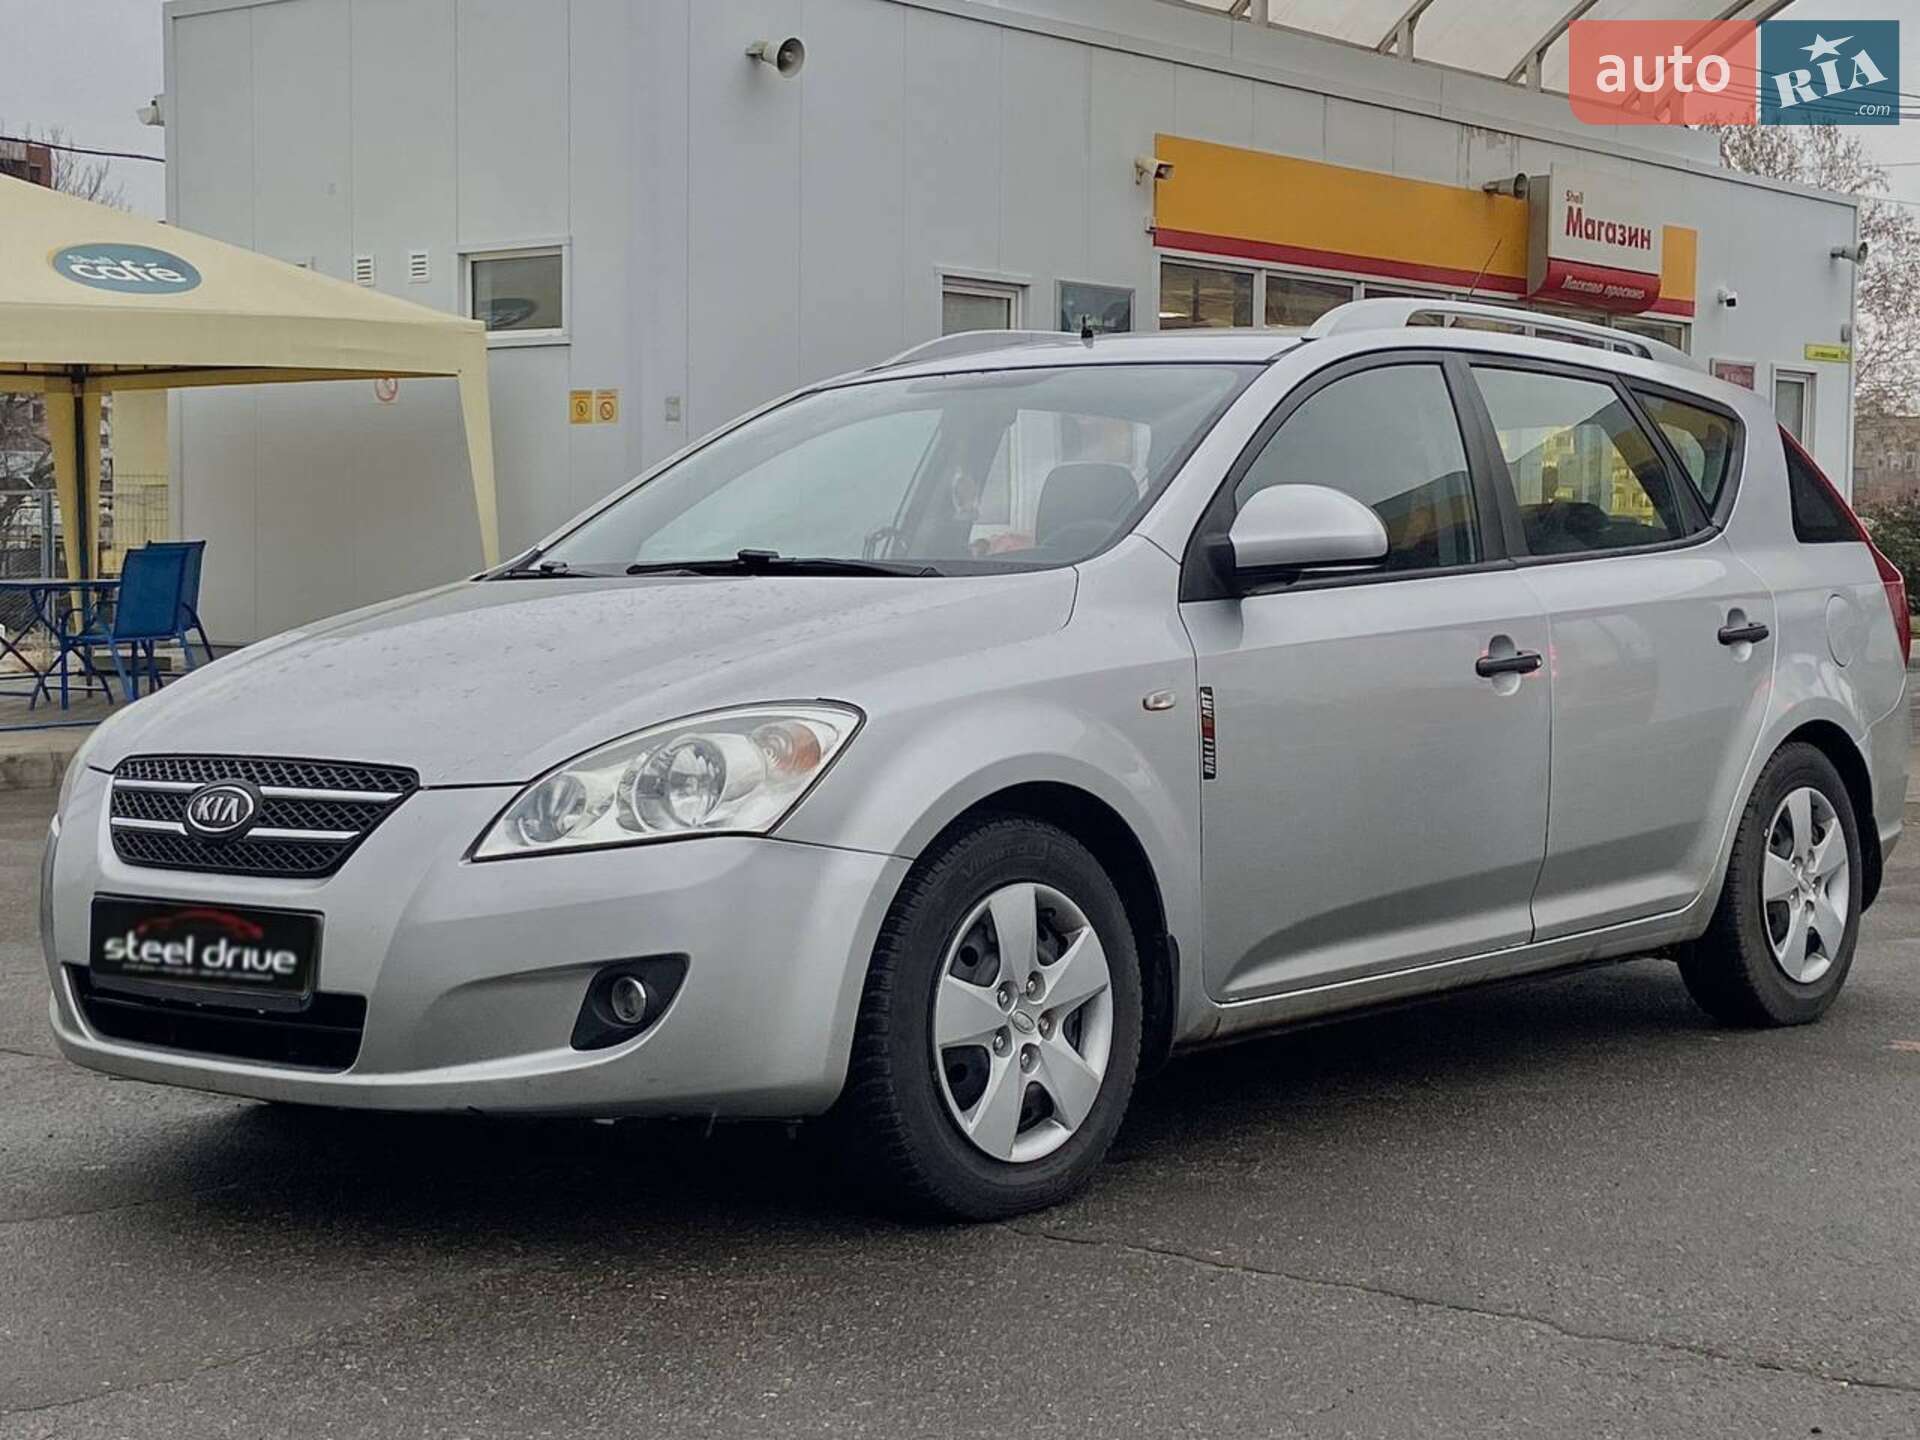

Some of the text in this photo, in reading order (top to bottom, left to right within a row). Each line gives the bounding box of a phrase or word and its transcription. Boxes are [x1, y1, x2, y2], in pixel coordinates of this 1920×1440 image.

[1565, 205, 1652, 251] Магазин
[69, 259, 187, 283] café
[196, 797, 239, 823] KIA
[104, 931, 194, 965] steel
[202, 938, 297, 974] drive
